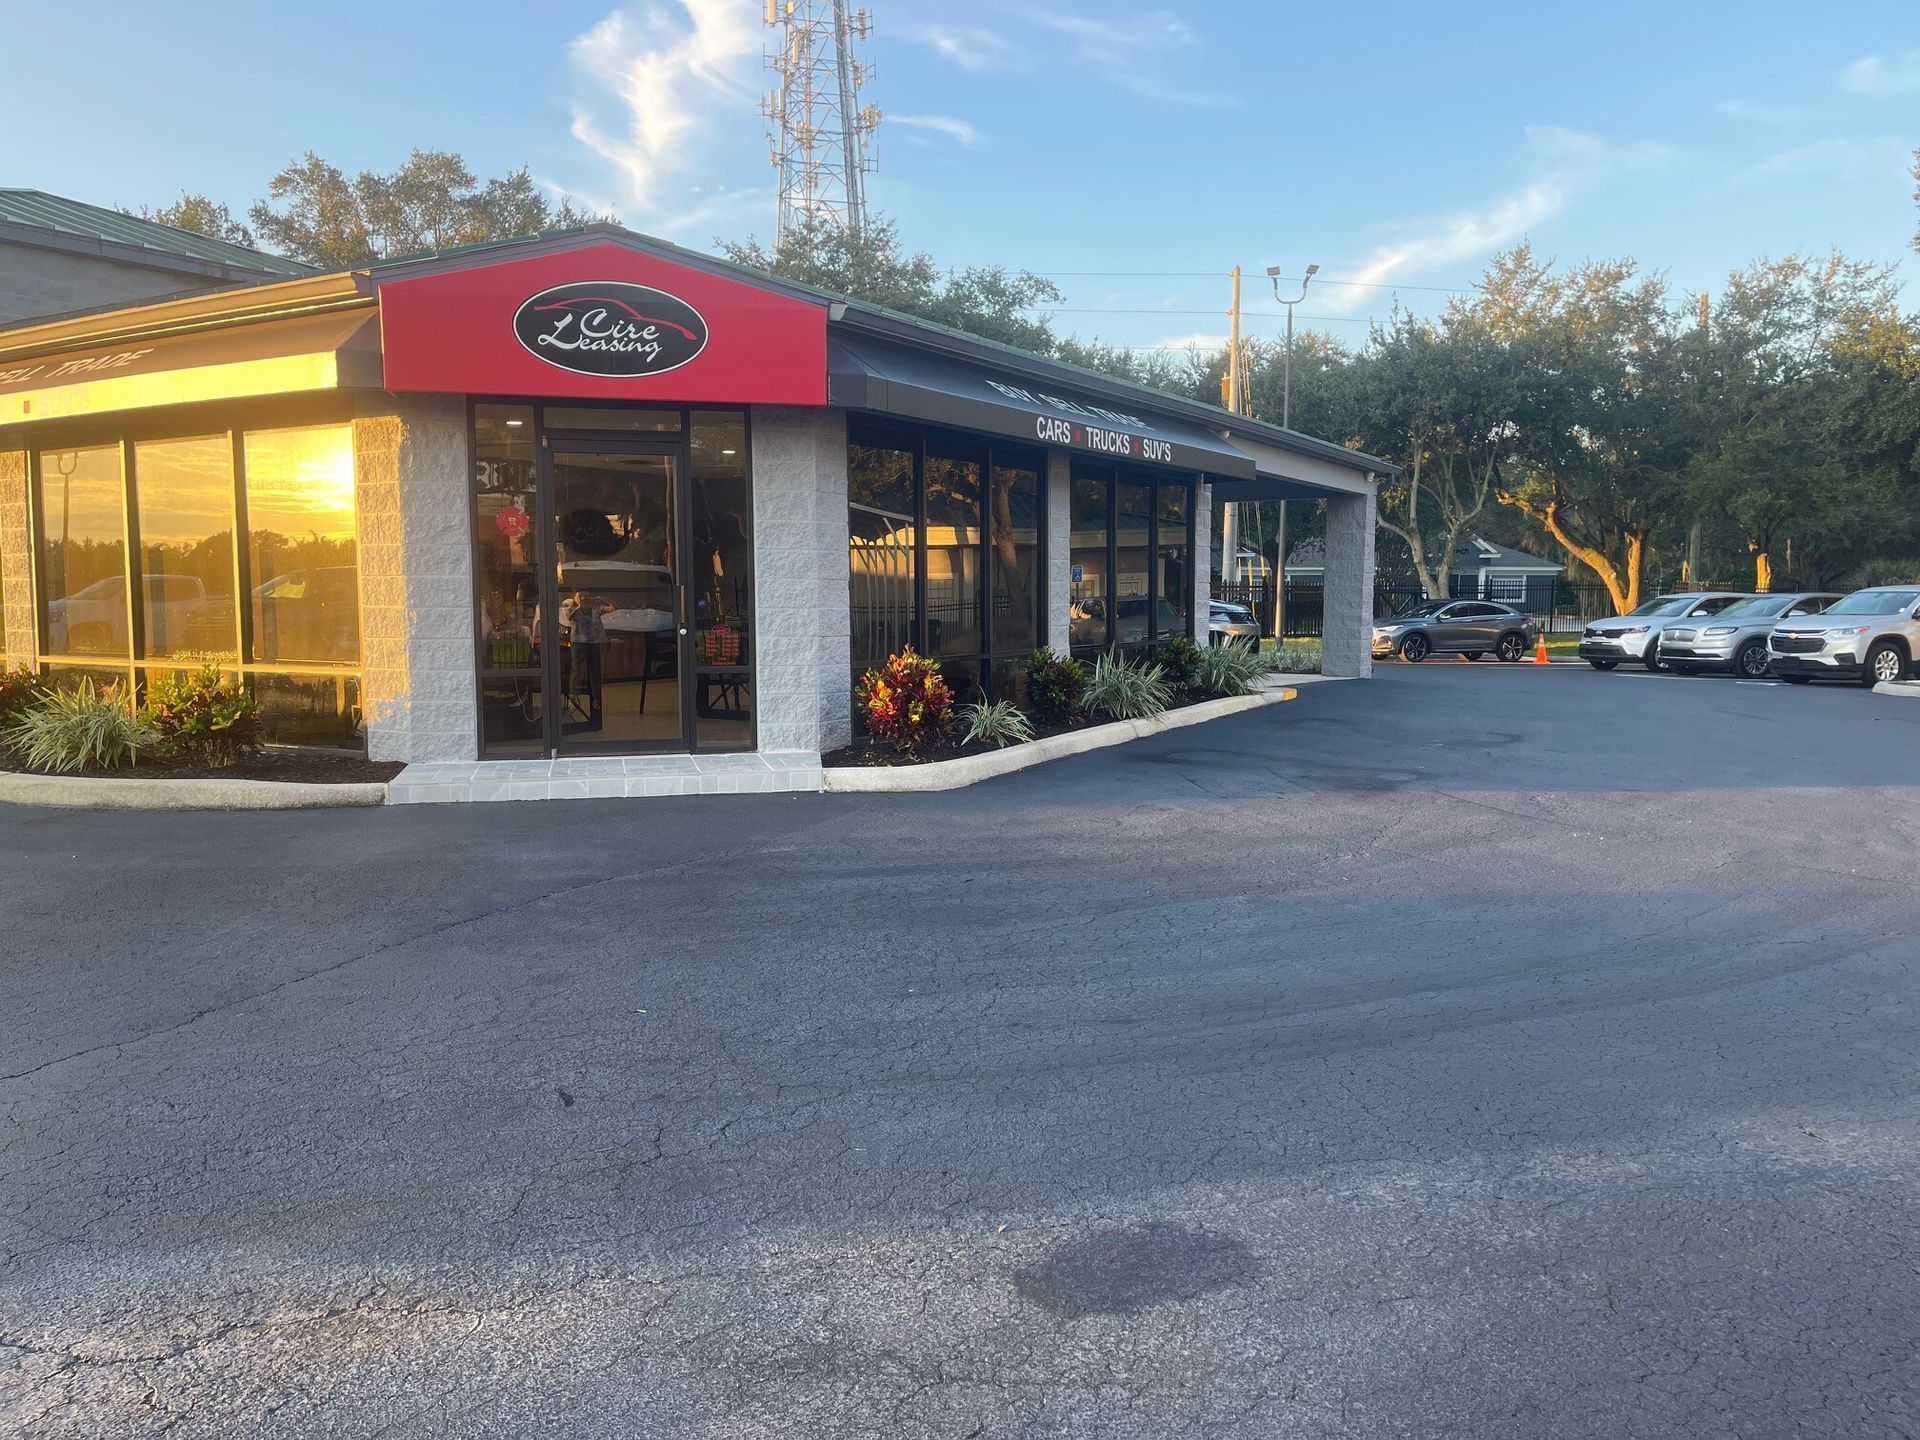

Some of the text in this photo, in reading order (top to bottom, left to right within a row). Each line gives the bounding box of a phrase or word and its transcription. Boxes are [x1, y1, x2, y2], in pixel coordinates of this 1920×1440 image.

[537, 313, 662, 362] Leasing
[580, 308, 660, 339] Cire
[45, 348, 154, 378] TRADE
[985, 380, 1042, 405] BUY
[1036, 416, 1171, 462] CARS TRUCKS SUV'S
